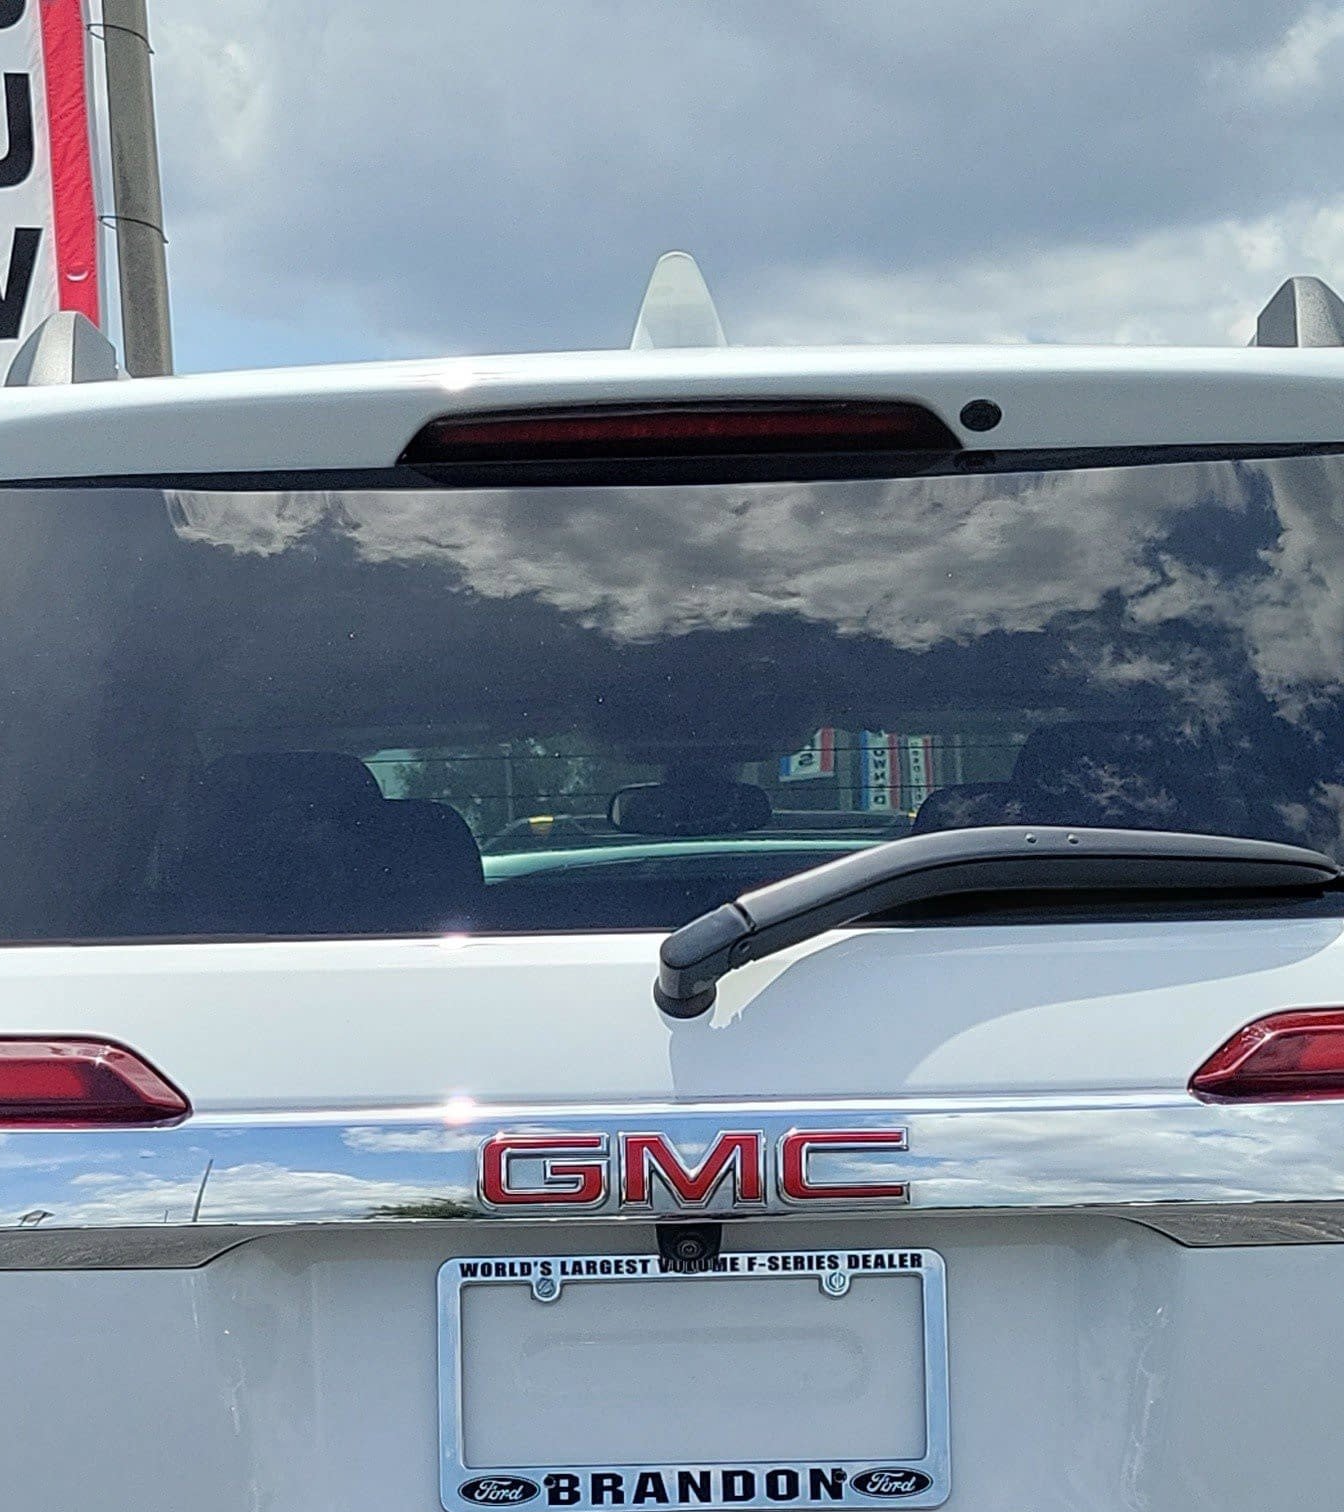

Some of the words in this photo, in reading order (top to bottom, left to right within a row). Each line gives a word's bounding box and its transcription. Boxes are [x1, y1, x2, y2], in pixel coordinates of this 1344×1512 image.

[476, 1127, 910, 1211] GMC
[460, 1261, 552, 1278] WORLD'S
[560, 1259, 651, 1276] LARGEST
[747, 1254, 839, 1271] F-SERIES
[847, 1253, 923, 1269] DEALER
[474, 1479, 524, 1501] Ford
[545, 1468, 844, 1506] BRANDON
[867, 1472, 917, 1493] Ford
